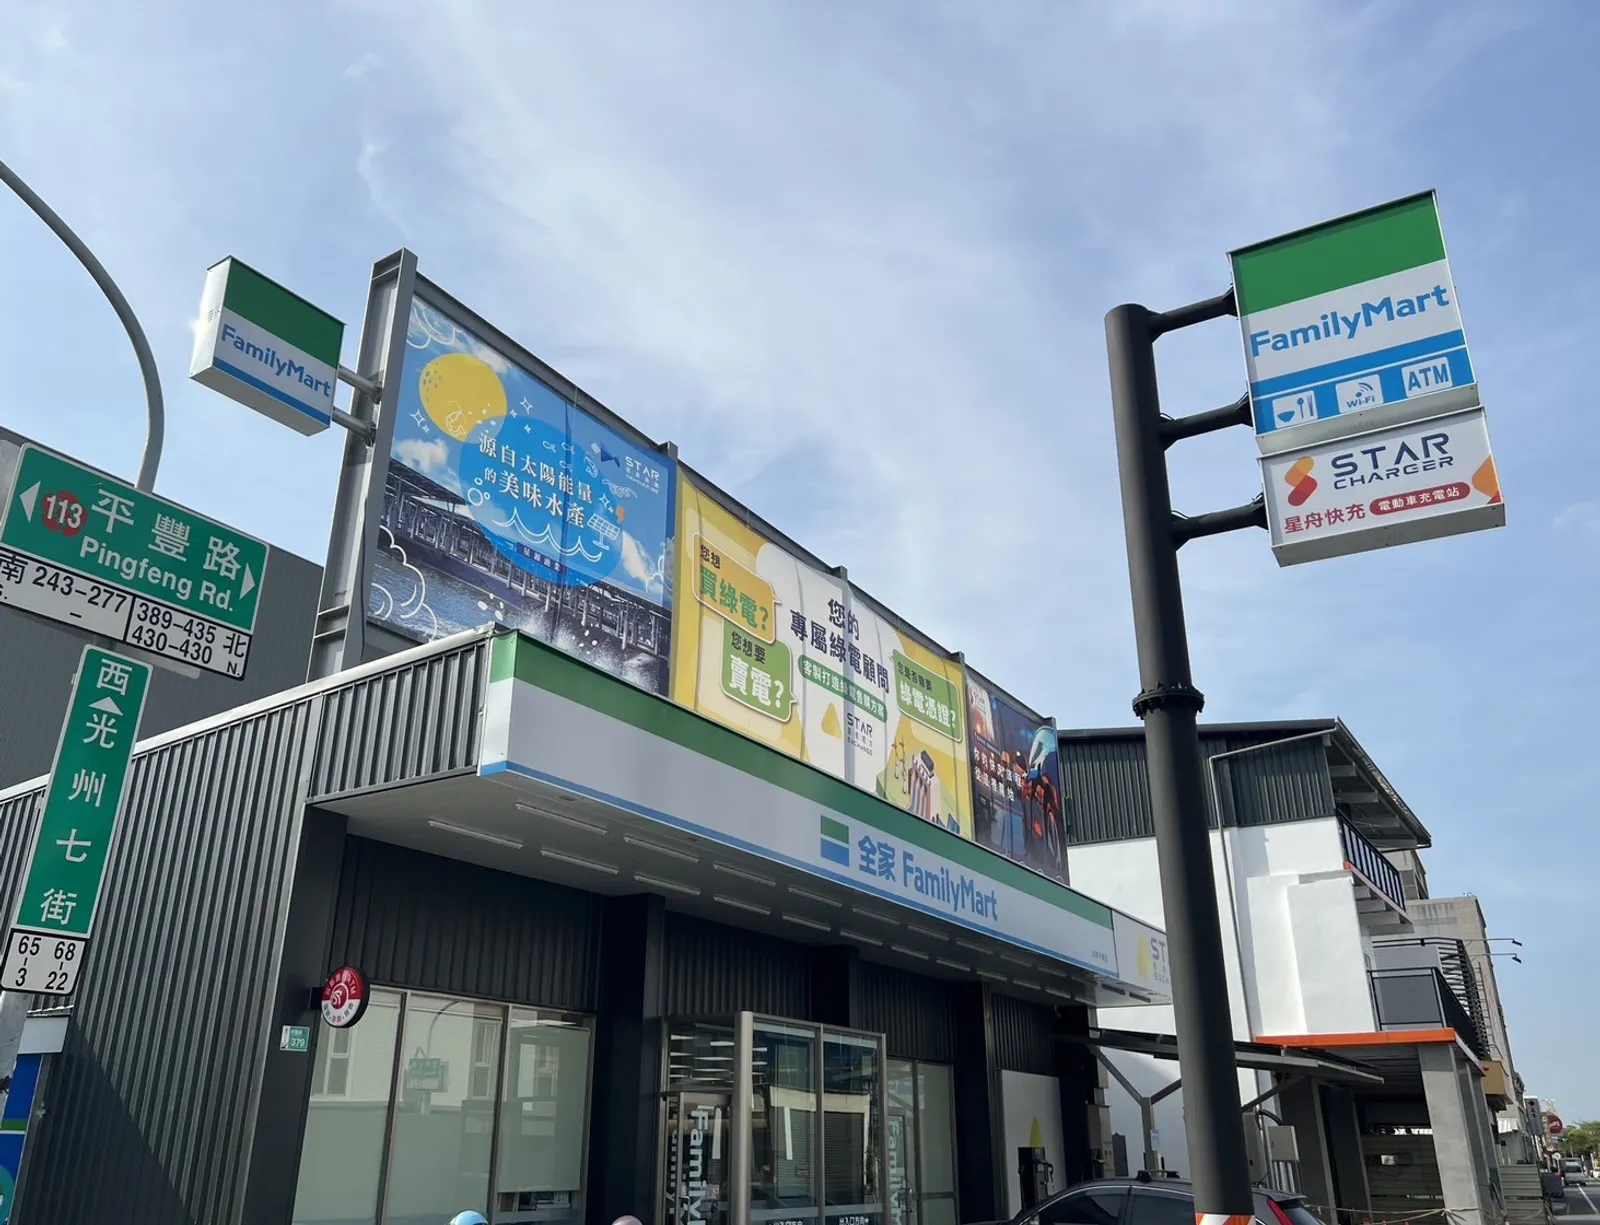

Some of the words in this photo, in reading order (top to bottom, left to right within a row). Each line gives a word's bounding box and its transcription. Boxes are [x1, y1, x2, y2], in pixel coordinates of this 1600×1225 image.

[1250, 285, 1449, 357] FamilyMart
[221, 324, 331, 397] FamilyMart
[1407, 363, 1450, 392] ATM
[478, 432, 593, 506] 源自太陽能量
[625, 455, 660, 481] STAR
[1331, 432, 1450, 478] STAR
[1333, 456, 1454, 490] CHARGER
[44, 494, 85, 529] 113
[484, 465, 586, 529] 的美味水產
[1378, 486, 1460, 512] 電動車充電站
[91, 488, 242, 581] 平豐路
[1284, 503, 1366, 534] 星舟快充
[1, 554, 28, 585] 南
[79, 536, 193, 601] Pingfeng
[199, 580, 234, 613] Rd.
[700, 544, 721, 570] 您想
[32, 566, 128, 615] 243-277
[700, 566, 769, 632] 買綠電?
[137, 602, 217, 645] 389-435
[828, 598, 859, 641] 您的
[131, 624, 213, 666] 430-430
[223, 633, 248, 659] 北
[731, 631, 766, 665] 您想要
[790, 609, 889, 694] 專屬綠電顧問
[96, 658, 133, 696] 西
[226, 661, 241, 677] N.
[729, 654, 785, 709] 賣電?
[847, 712, 873, 738] STAR
[40, 713, 118, 926] 光州七街
[858, 835, 896, 882] 全家
[902, 850, 998, 922] FamilyMart
[18, 935, 42, 956] 65
[54, 940, 77, 962] 68
[15, 967, 27, 987] 3
[45, 971, 69, 992] 22
[290, 1037, 305, 1047] 379
[684, 1110, 709, 1225] Family
